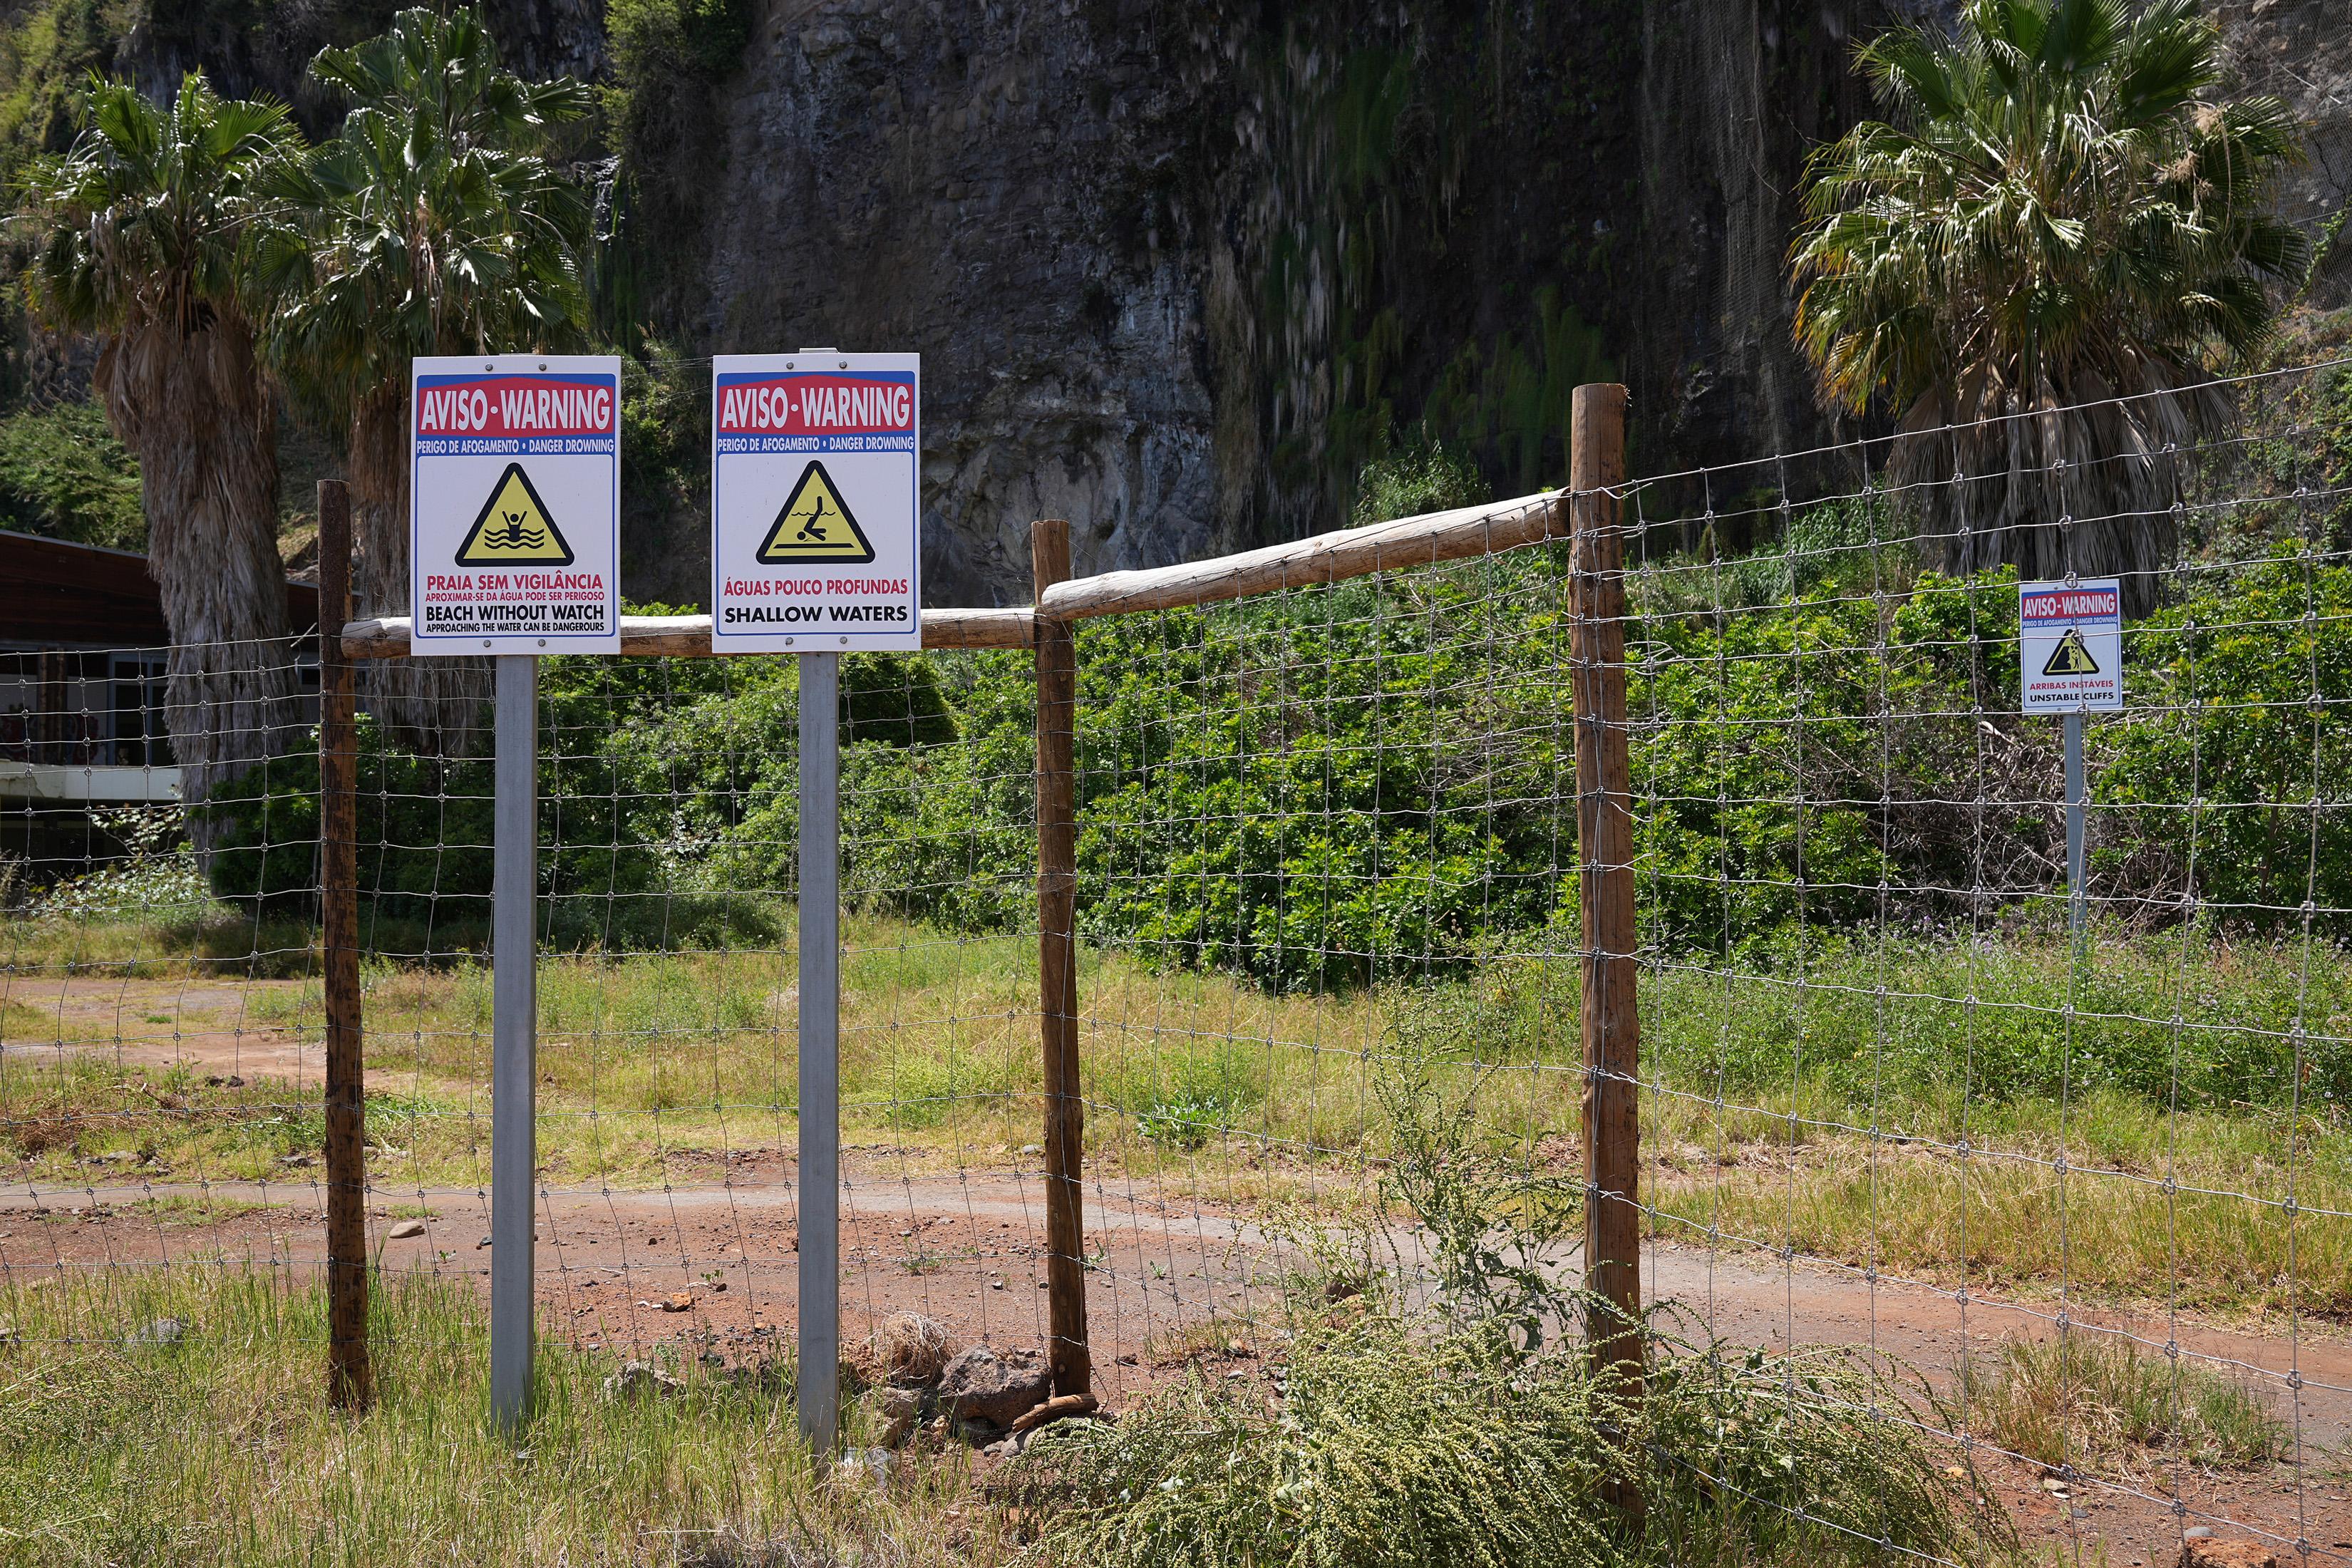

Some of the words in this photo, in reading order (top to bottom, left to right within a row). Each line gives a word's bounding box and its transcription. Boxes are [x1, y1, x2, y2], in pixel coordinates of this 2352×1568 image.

[421, 388, 488, 430] AVISO
[500, 388, 610, 430] WARNING
[721, 387, 788, 428] AVISO
[801, 386, 909, 427] WARNING
[417, 440, 446, 454] PERIGO
[449, 441, 459, 453] DE
[460, 440, 519, 453] AFOGAMENTO
[529, 440, 564, 453] DANGER
[566, 439, 614, 453] DROWNING
[718, 438, 747, 452] PERIGO
[750, 438, 759, 450] DE
[762, 437, 820, 451] AFOGAMENTO
[830, 437, 864, 450] DANGER
[866, 436, 914, 449] DROWNING
[427, 575, 473, 590] PRAIA
[478, 574, 508, 589] SEM
[514, 570, 602, 589] VIGILÂNCIA
[724, 577, 770, 596] ÁGUAS
[775, 580, 822, 595] POUCO
[827, 579, 907, 594] PROFUNDAS
[425, 592, 485, 602] APROXIMAR-SE
[486, 592, 498, 602] DA
[500, 589, 523, 602] ÁGUA
[525, 592, 547, 601] PODE
[549, 592, 563, 601] SER
[565, 591, 604, 600] PERIGOSO
[426, 606, 473, 621] BEACH
[478, 605, 547, 620] WITHOUT
[552, 604, 604, 620] WATCH
[725, 607, 822, 623] SHALLOW
[828, 605, 907, 621] WATERS
[2024, 597, 2056, 617] AVISO
[2062, 594, 2115, 615] WARNING
[426, 623, 480, 633] APPROACHING
[482, 623, 495, 631] THE
[497, 622, 522, 631] WATER
[523, 622, 540, 631] CAN
[542, 622, 551, 631] BE
[553, 621, 604, 631] DANGEROURS
[2030, 681, 2066, 690] ARRIBAS
[2070, 679, 2113, 688] INSTÁVEIS
[2031, 693, 2079, 702] UNSTABLE
